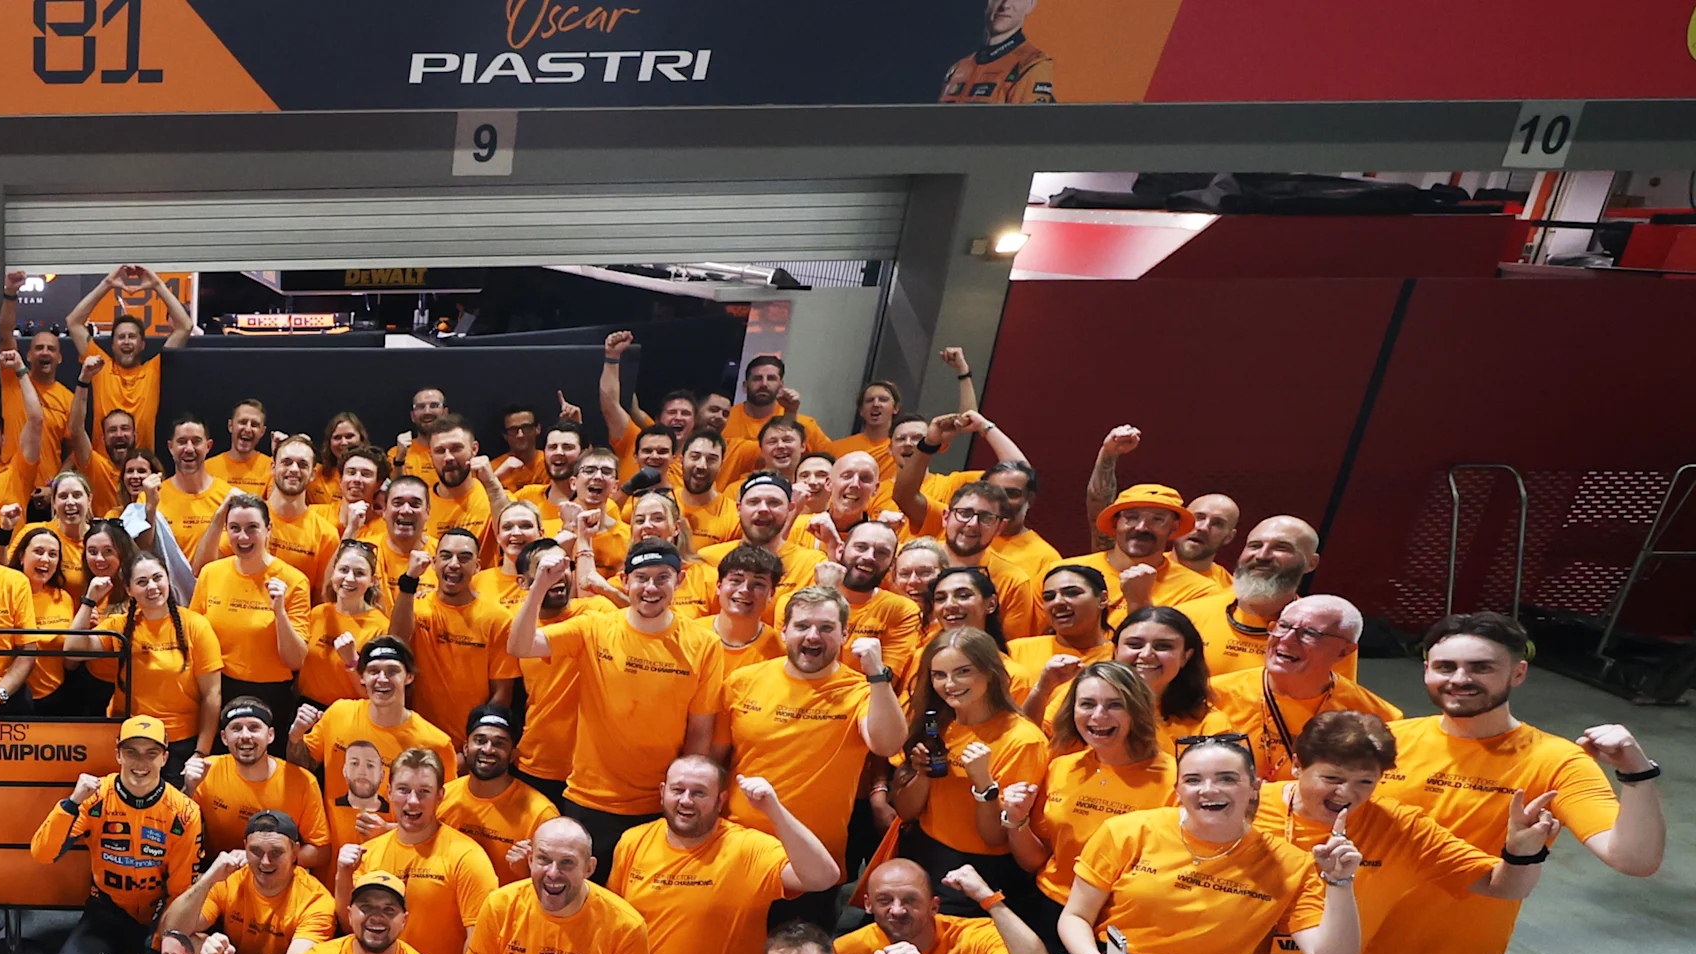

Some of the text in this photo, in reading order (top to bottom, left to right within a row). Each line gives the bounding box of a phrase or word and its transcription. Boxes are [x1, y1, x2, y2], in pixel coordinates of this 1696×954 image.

[505, 0, 641, 51] Oscar
[32, 0, 164, 85] 81
[408, 49, 713, 85] PIASTRI
[472, 124, 497, 164] 9
[1518, 113, 1573, 156] 10
[1225, 644, 1255, 654] WORLD
[775, 710, 802, 720] WORLD
[1425, 777, 1463, 789] WORLD
[1075, 800, 1105, 812] WORLD
[102, 852, 124, 865] DELL
[1131, 863, 1158, 875] TEAM
[1177, 874, 1273, 903] WORLD CHAMPIONS
